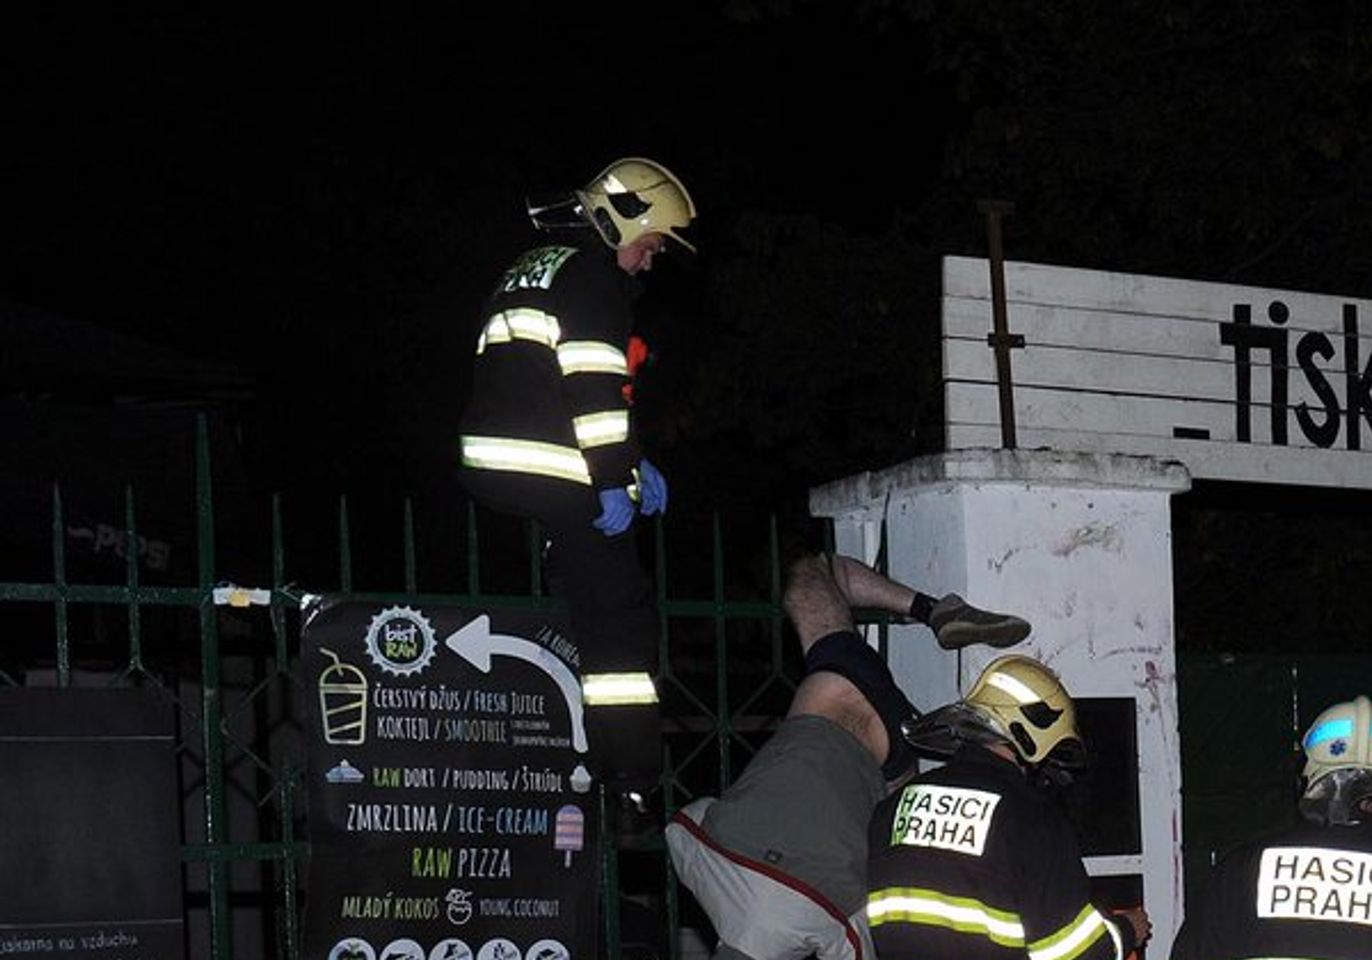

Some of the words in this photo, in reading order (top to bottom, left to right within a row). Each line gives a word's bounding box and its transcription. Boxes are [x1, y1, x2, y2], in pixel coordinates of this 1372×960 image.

[452, 769, 510, 791] PUDDING
[347, 804, 438, 833] ZMRZLINA
[443, 803, 453, 831] /
[458, 806, 549, 835] ICE-CREAM
[901, 792, 990, 821] HASICI
[896, 816, 976, 848] PRAHA
[412, 848, 452, 877] RAW
[457, 850, 512, 878] PIZZA
[341, 891, 393, 919] MLADÝ
[394, 897, 440, 920] KOKOS
